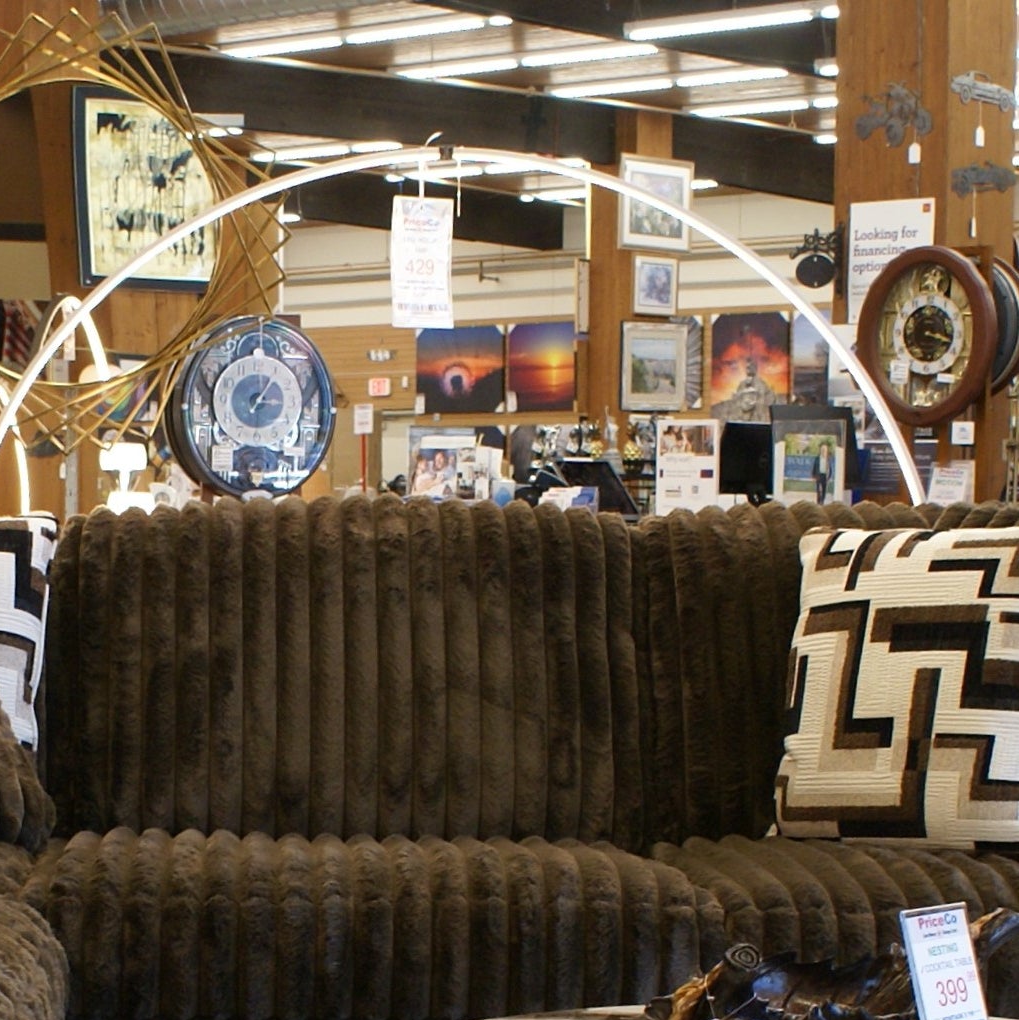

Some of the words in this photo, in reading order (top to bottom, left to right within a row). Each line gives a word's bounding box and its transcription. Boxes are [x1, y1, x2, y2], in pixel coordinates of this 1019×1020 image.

[854, 227, 898, 241] Looking
[901, 225, 918, 238] for
[405, 258, 435, 276] 429
[917, 913, 958, 929] PriceCo
[936, 977, 968, 1007] 399
